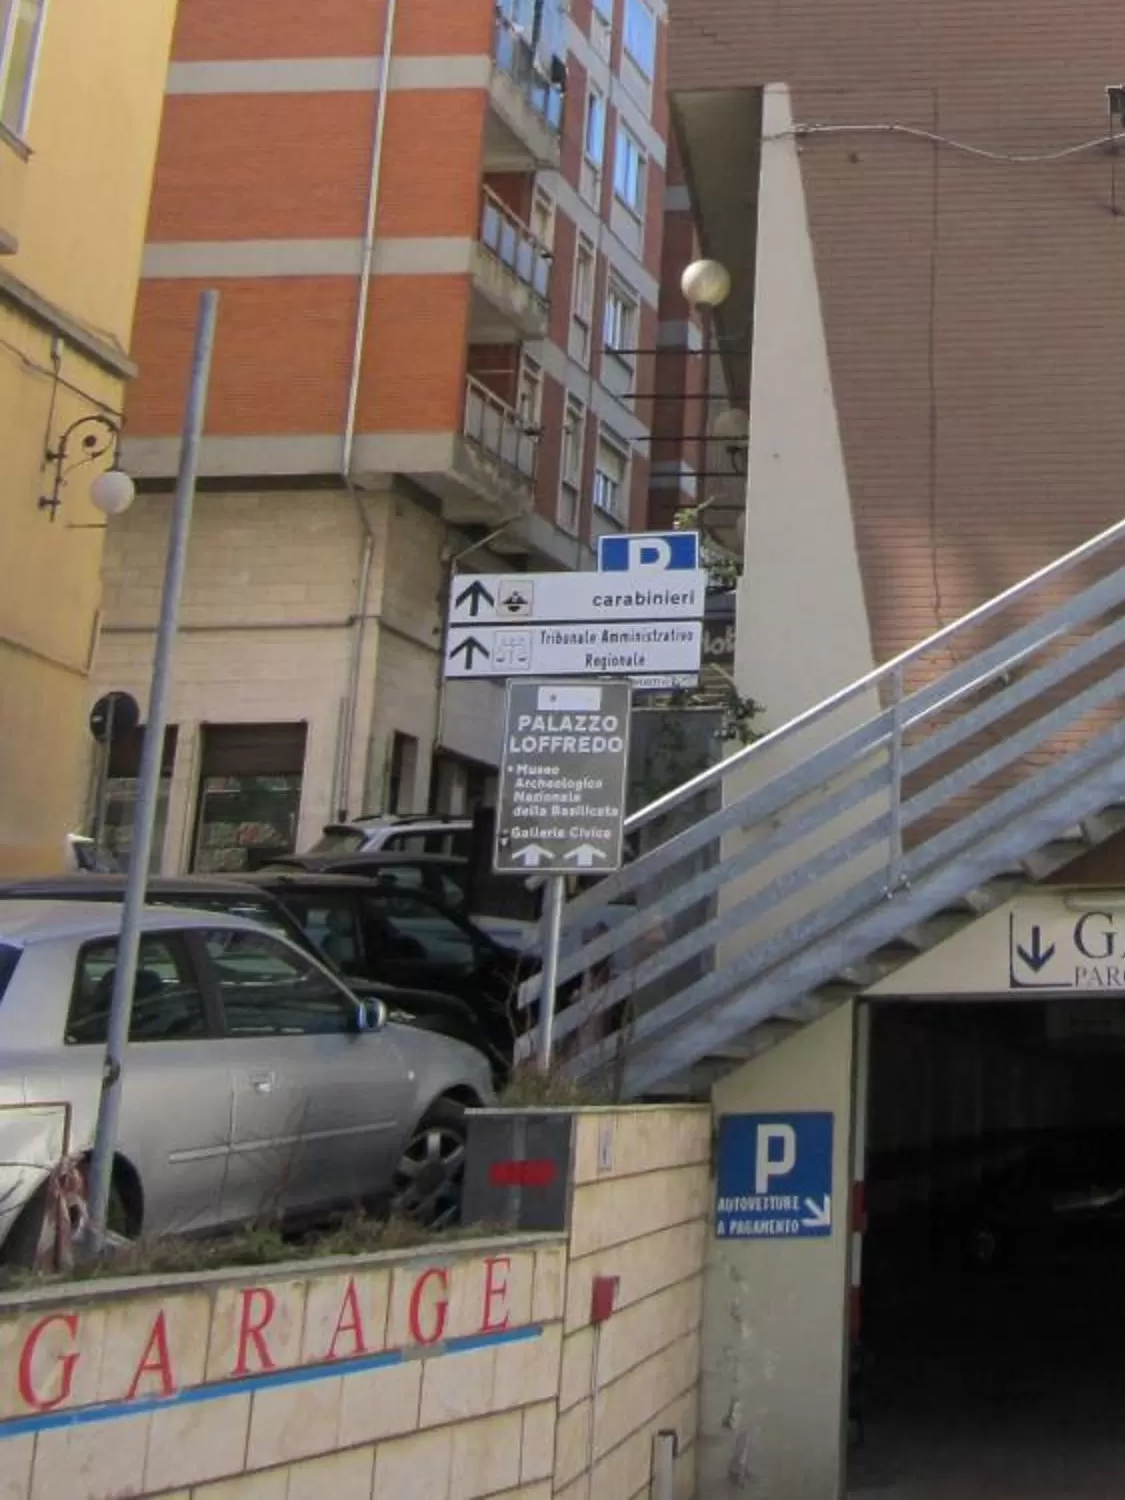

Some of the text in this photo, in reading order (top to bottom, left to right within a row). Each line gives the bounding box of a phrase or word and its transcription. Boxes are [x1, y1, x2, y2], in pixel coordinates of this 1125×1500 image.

[592, 588, 696, 607] carabinieri
[540, 626, 694, 645] Tribunale Amministrativo
[585, 651, 646, 670] Regionale
[517, 714, 619, 733] PALAZZO
[509, 735, 624, 753] LOFFREDO
[516, 764, 560, 776] Museo
[514, 777, 603, 790] Archeologico
[512, 804, 619, 817] della Basilicata
[569, 826, 612, 839] Civica
[755, 1123, 796, 1195] P
[716, 1219, 799, 1236] A PAGAMENTO
[16, 1255, 513, 1412] GARAGE
